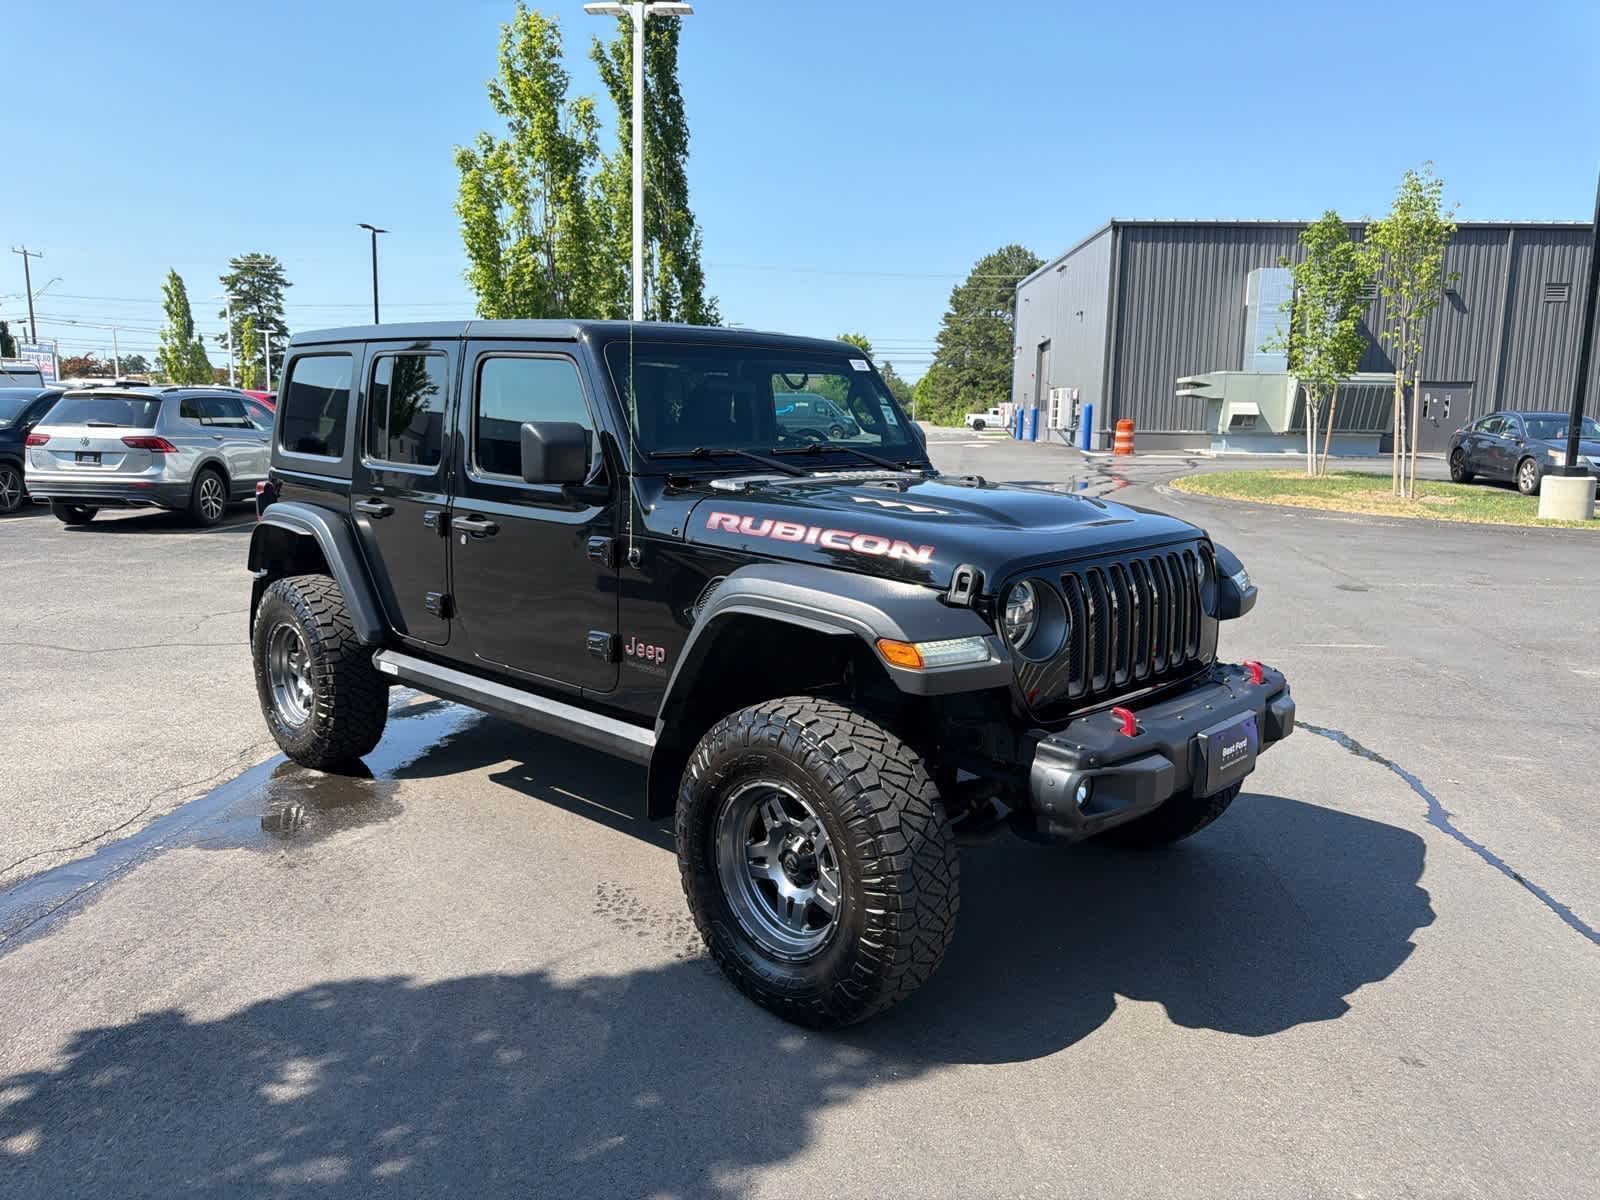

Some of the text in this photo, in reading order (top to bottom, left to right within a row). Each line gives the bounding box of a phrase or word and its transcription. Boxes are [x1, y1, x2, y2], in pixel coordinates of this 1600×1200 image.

[706, 511, 935, 564] RUBICON
[624, 636, 665, 665] Jeep
[1236, 737, 1247, 749] Ford
